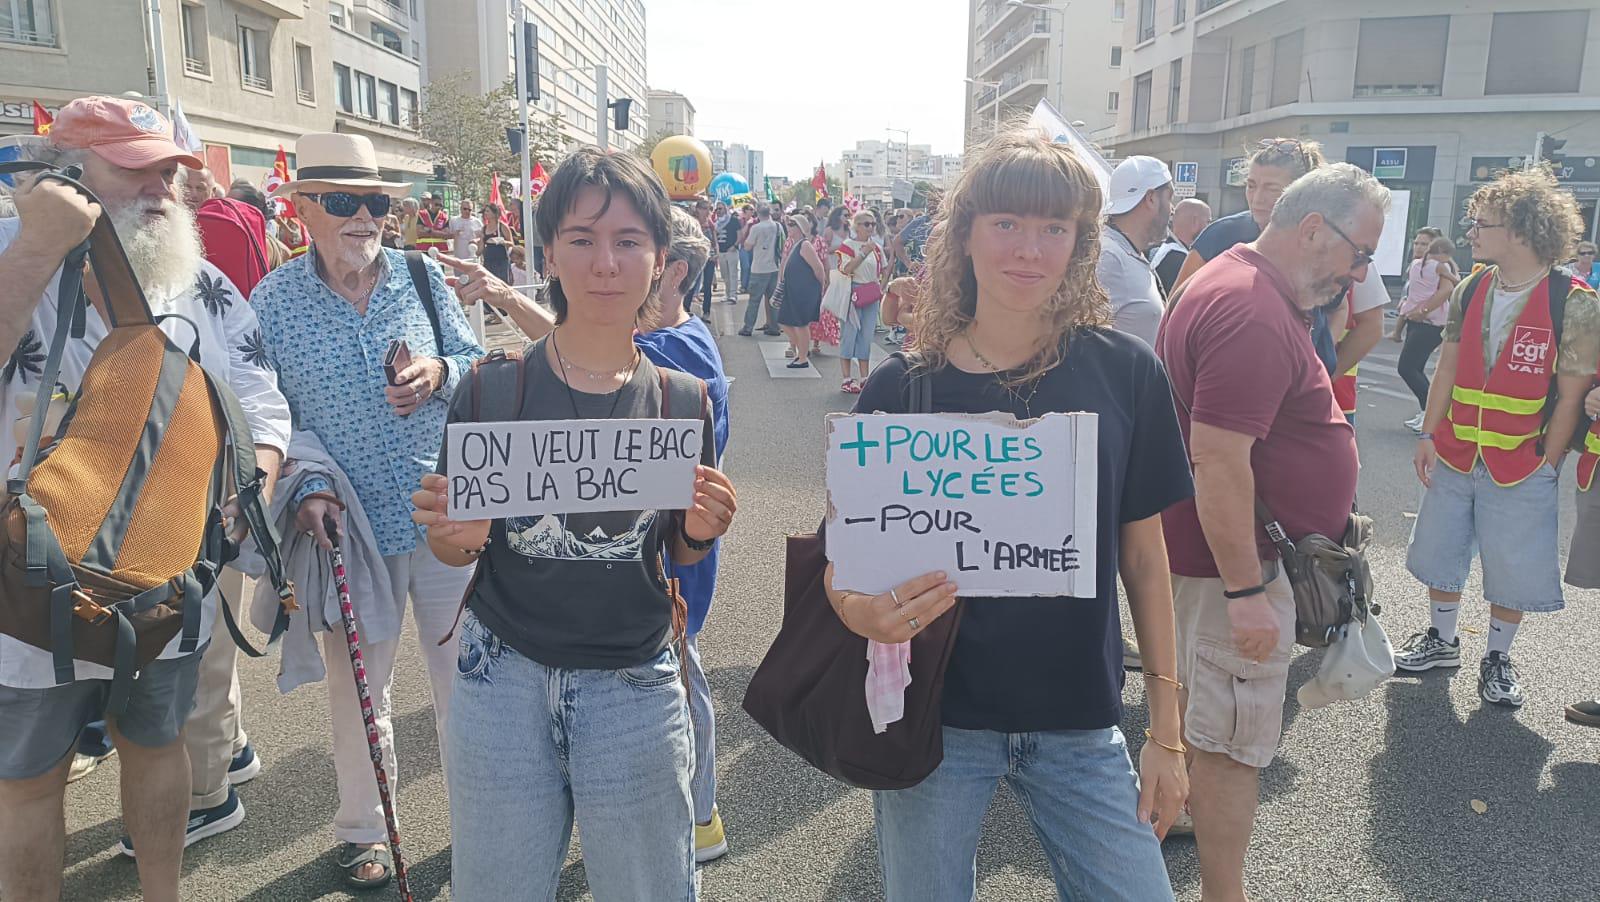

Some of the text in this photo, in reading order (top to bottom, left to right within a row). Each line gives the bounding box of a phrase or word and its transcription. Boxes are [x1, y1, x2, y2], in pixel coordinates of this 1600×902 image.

[1513, 343, 1546, 362] cgt
[462, 427, 697, 471] ON VEUT LE BAC
[985, 433, 1043, 463] LES
[452, 467, 639, 510] PAS LA BAC
[902, 466, 1045, 499] LYCÉES
